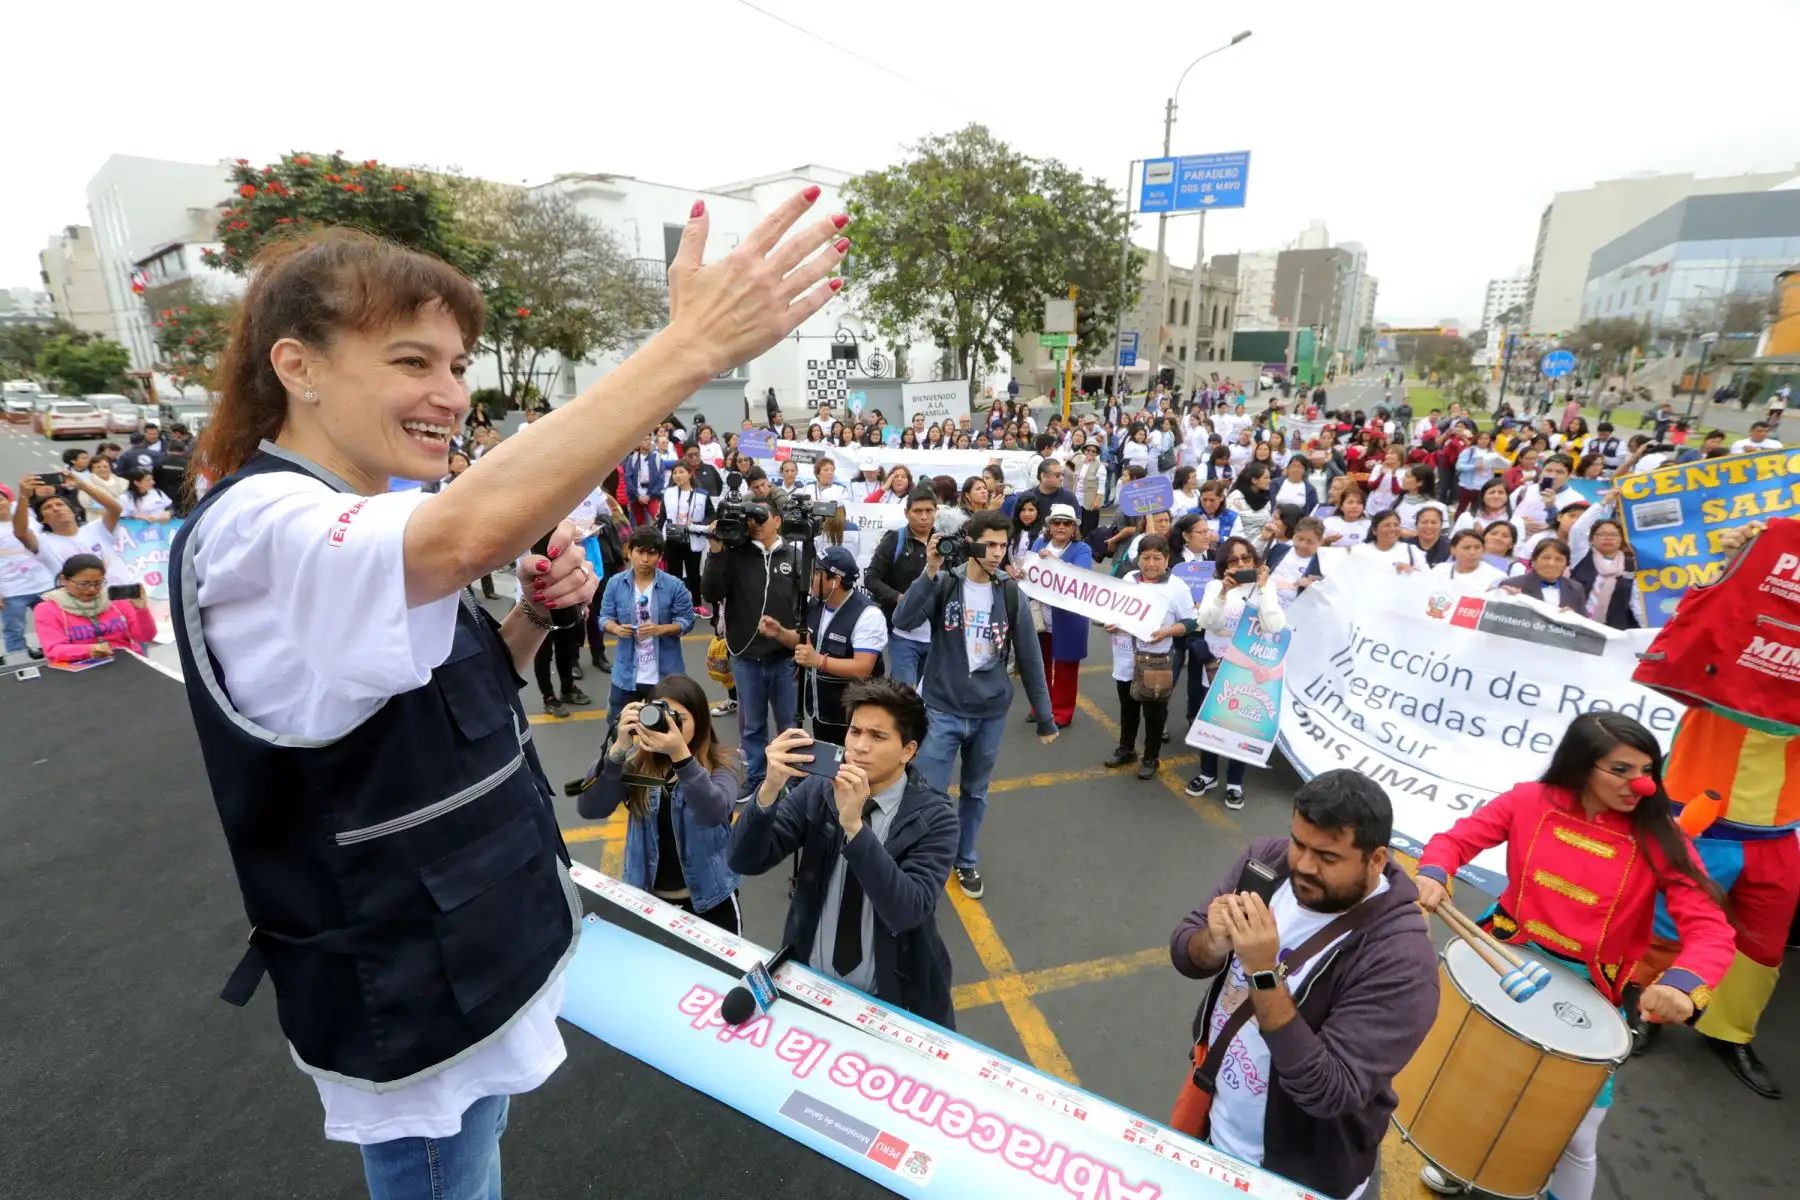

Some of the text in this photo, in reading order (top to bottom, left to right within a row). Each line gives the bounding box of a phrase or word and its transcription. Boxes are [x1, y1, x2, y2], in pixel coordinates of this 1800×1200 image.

[1184, 167, 1239, 181] PARADERO
[912, 392, 957, 403] BIENVENIDO
[1028, 565, 1152, 621] CONAMOVIDI
[1636, 560, 1727, 592] COM
[1484, 611, 1532, 629] Ministerio
[1533, 621, 1546, 631] de
[1548, 624, 1576, 638] Salud
[1351, 622, 1676, 732] irección de Rede
[1304, 673, 1365, 732] Lima
[1376, 721, 1438, 760] Sur
[1501, 719, 1554, 754] de
[1352, 755, 1439, 802] LIMA
[774, 974, 821, 1001] RAGIL
[775, 1027, 831, 1079] la
[868, 1019, 934, 1054] FRAGIL
[992, 1074, 1070, 1113] FRAGIL
[829, 1053, 1162, 1200] Abracemos
[875, 1142, 901, 1160] PERÚ
[1137, 1136, 1231, 1184] FRAGIL
